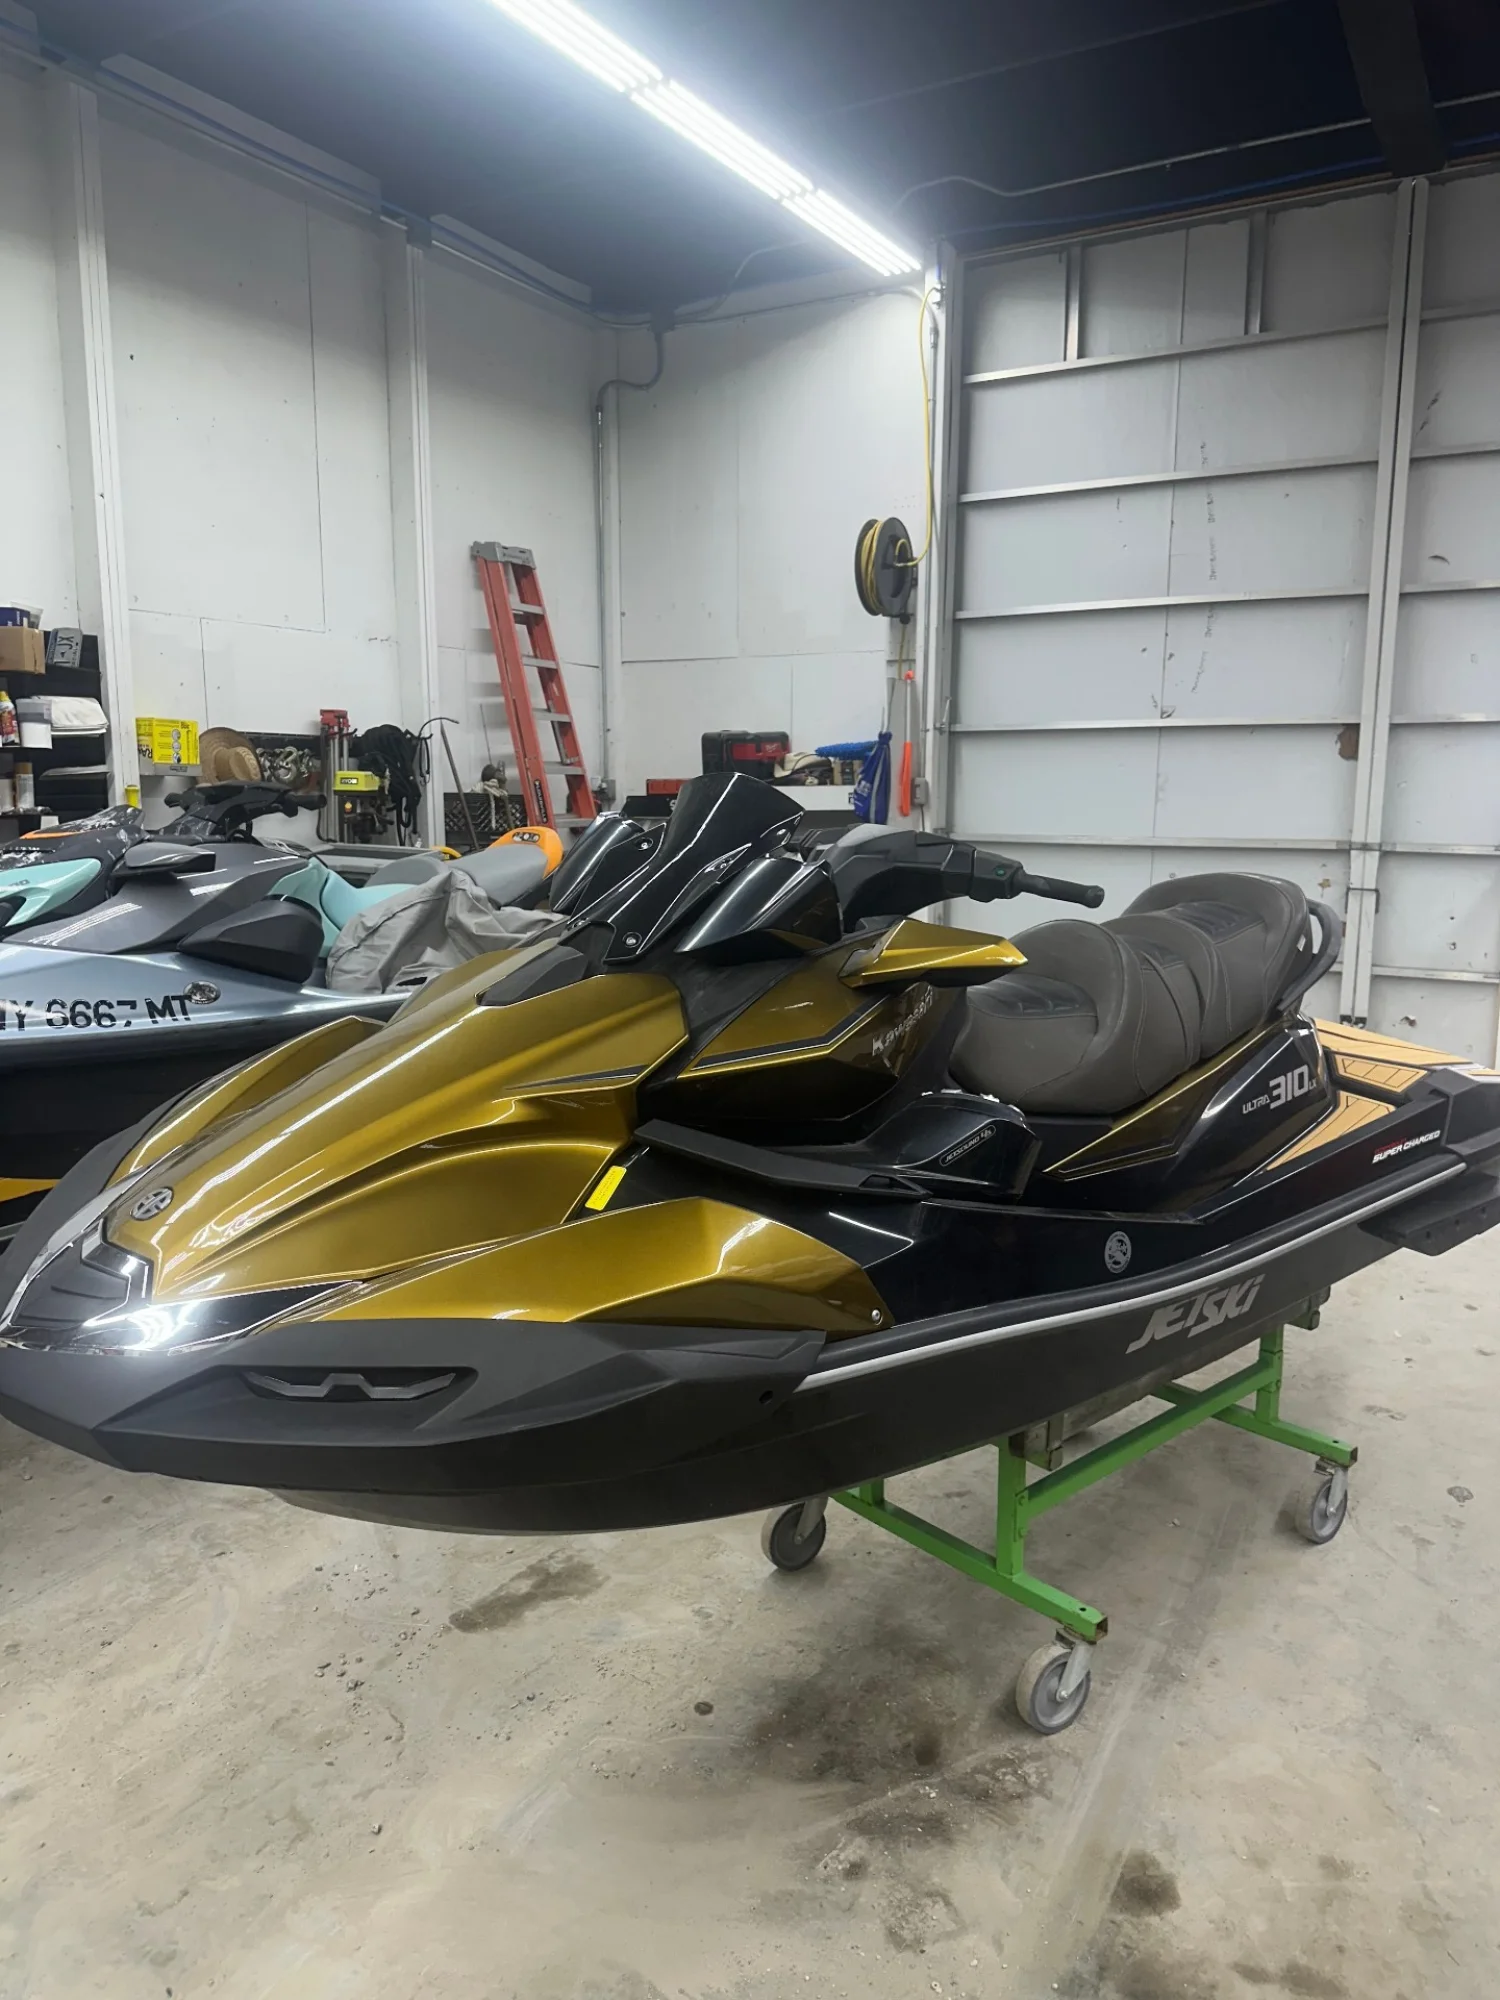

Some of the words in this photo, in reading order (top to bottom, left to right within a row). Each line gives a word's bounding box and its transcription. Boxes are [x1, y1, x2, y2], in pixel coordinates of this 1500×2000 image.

[46, 998, 137, 1029] 6667
[145, 994, 191, 1024] MT
[1242, 1094, 1271, 1114] ULTRA
[1269, 1064, 1309, 1109] 310
[945, 1136, 980, 1162] JETSOUND
[1371, 1144, 1403, 1164] SUPER
[1403, 1129, 1441, 1150] CHARGED
